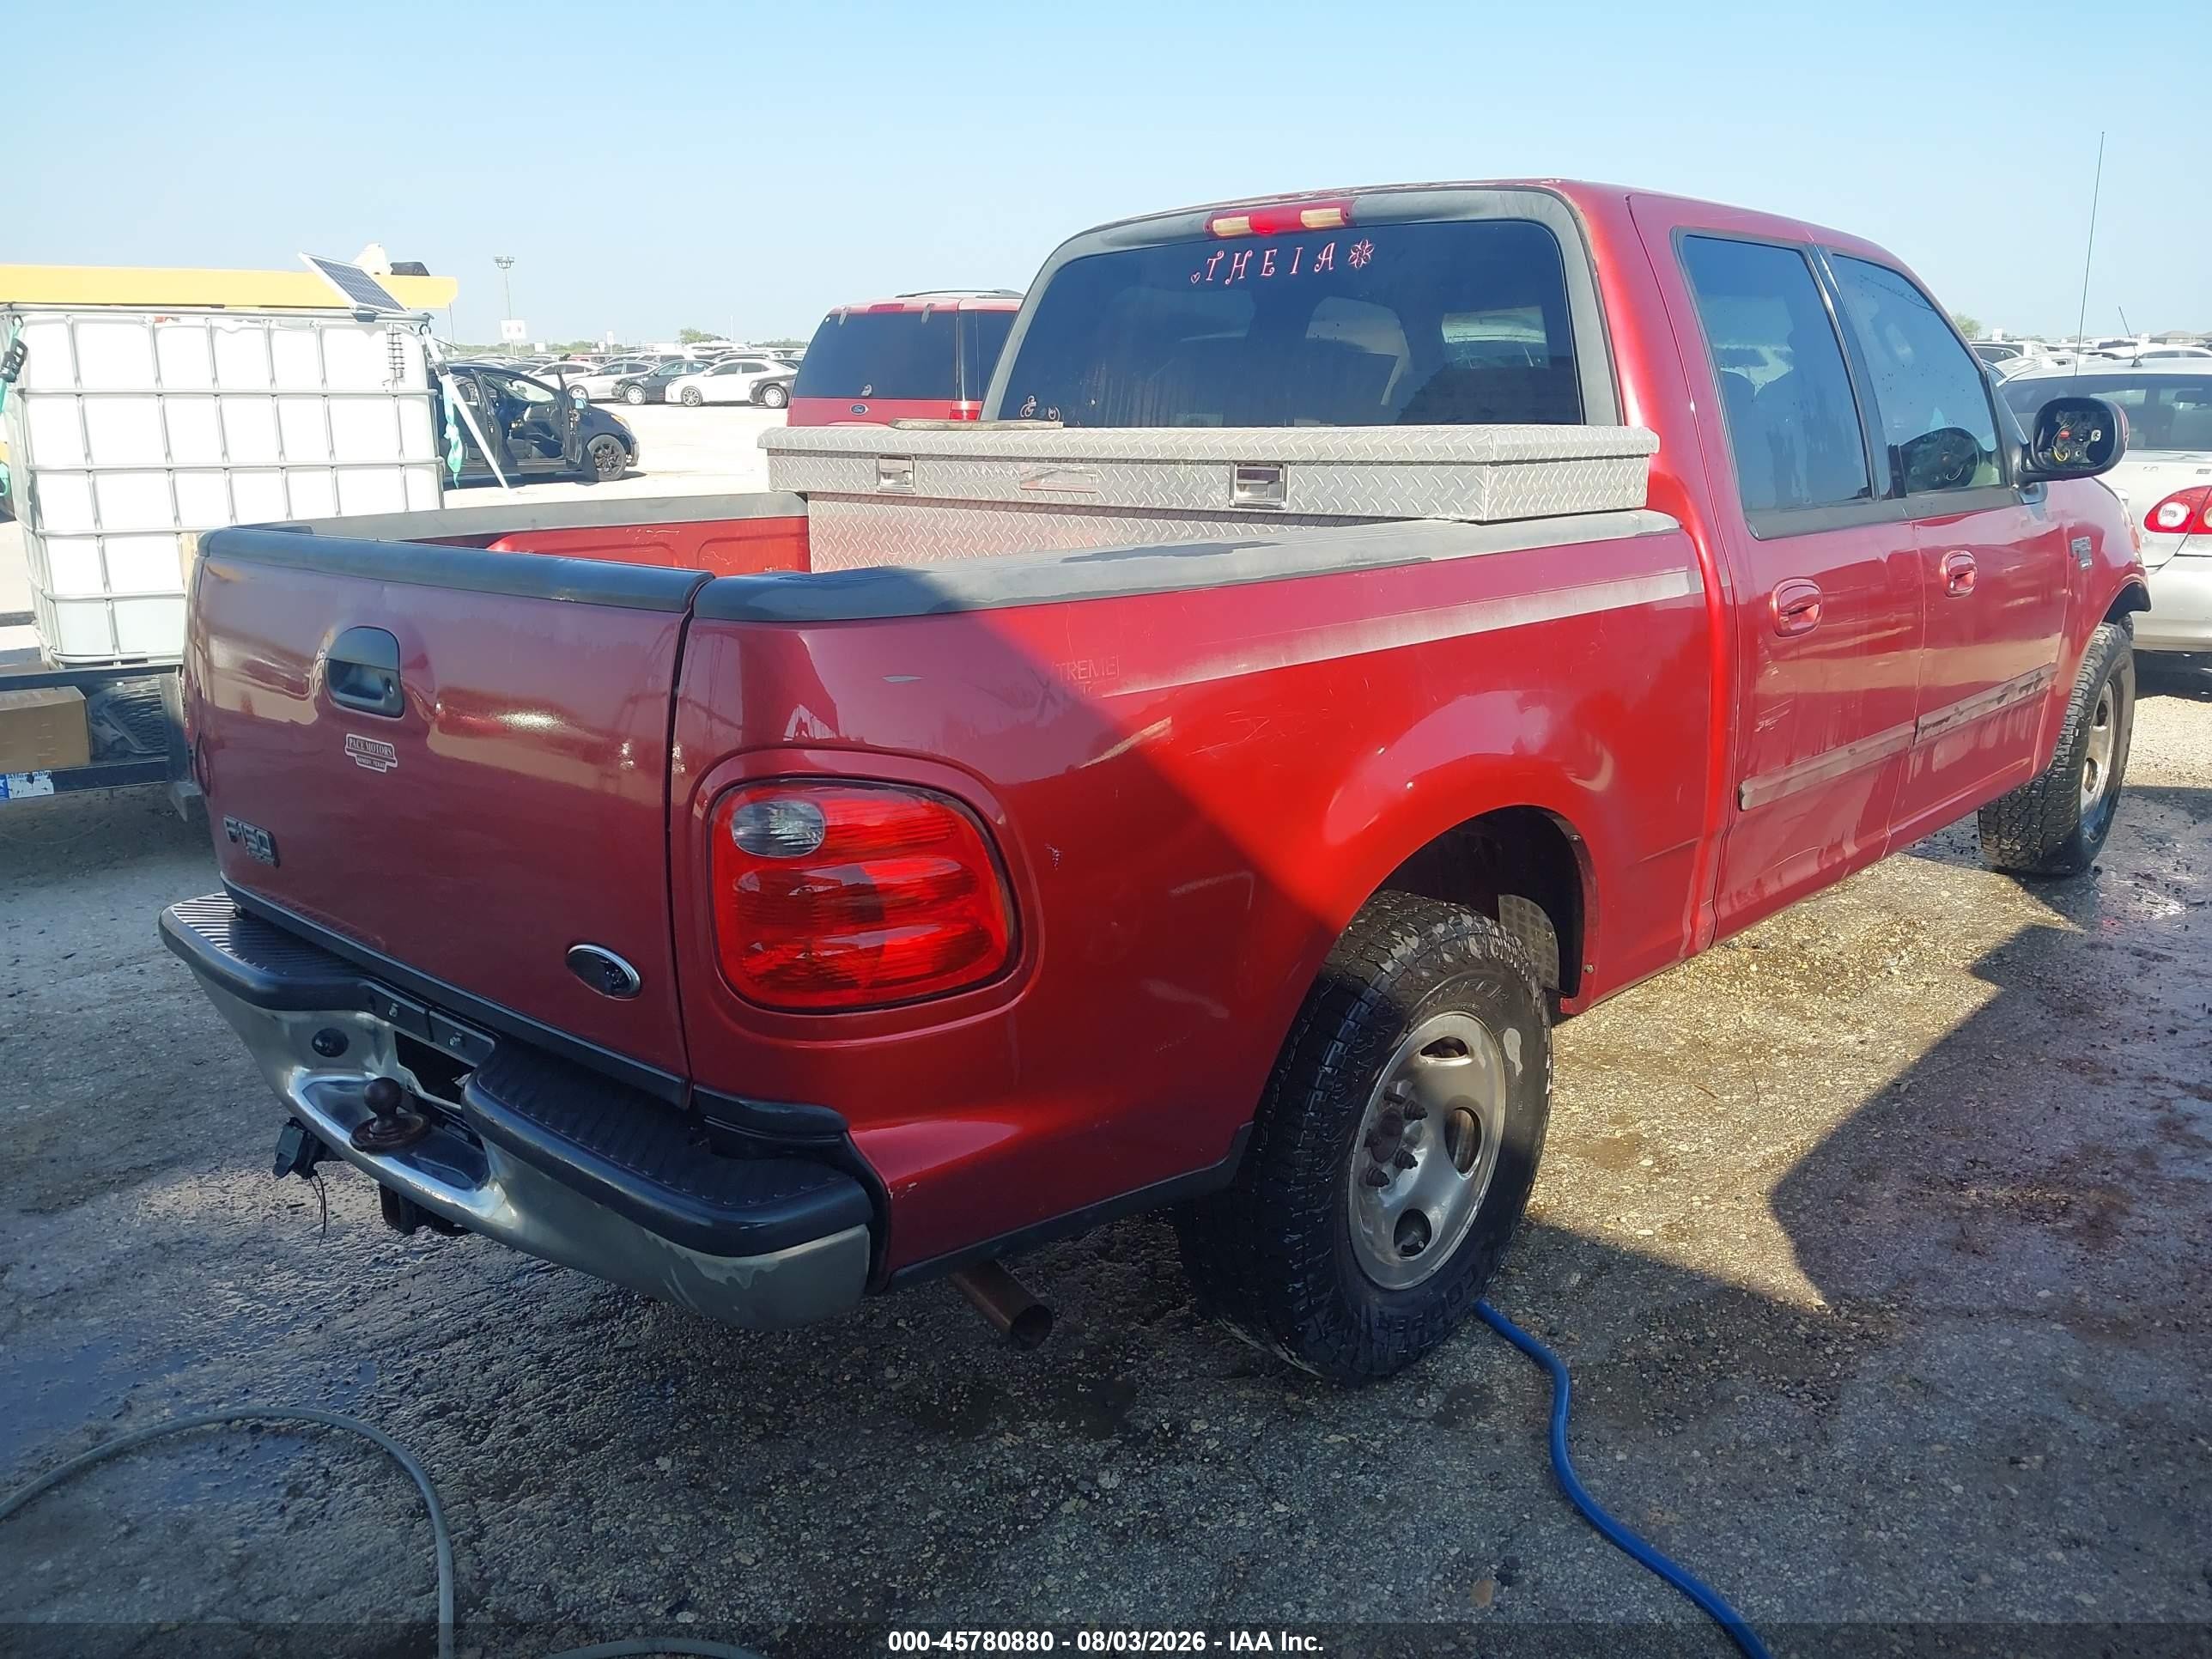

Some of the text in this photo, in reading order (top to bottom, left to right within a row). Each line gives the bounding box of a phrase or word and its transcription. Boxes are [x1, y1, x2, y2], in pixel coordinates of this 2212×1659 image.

[1205, 240, 1336, 285] THEIA
[349, 737, 392, 757] PACE MOTORS
